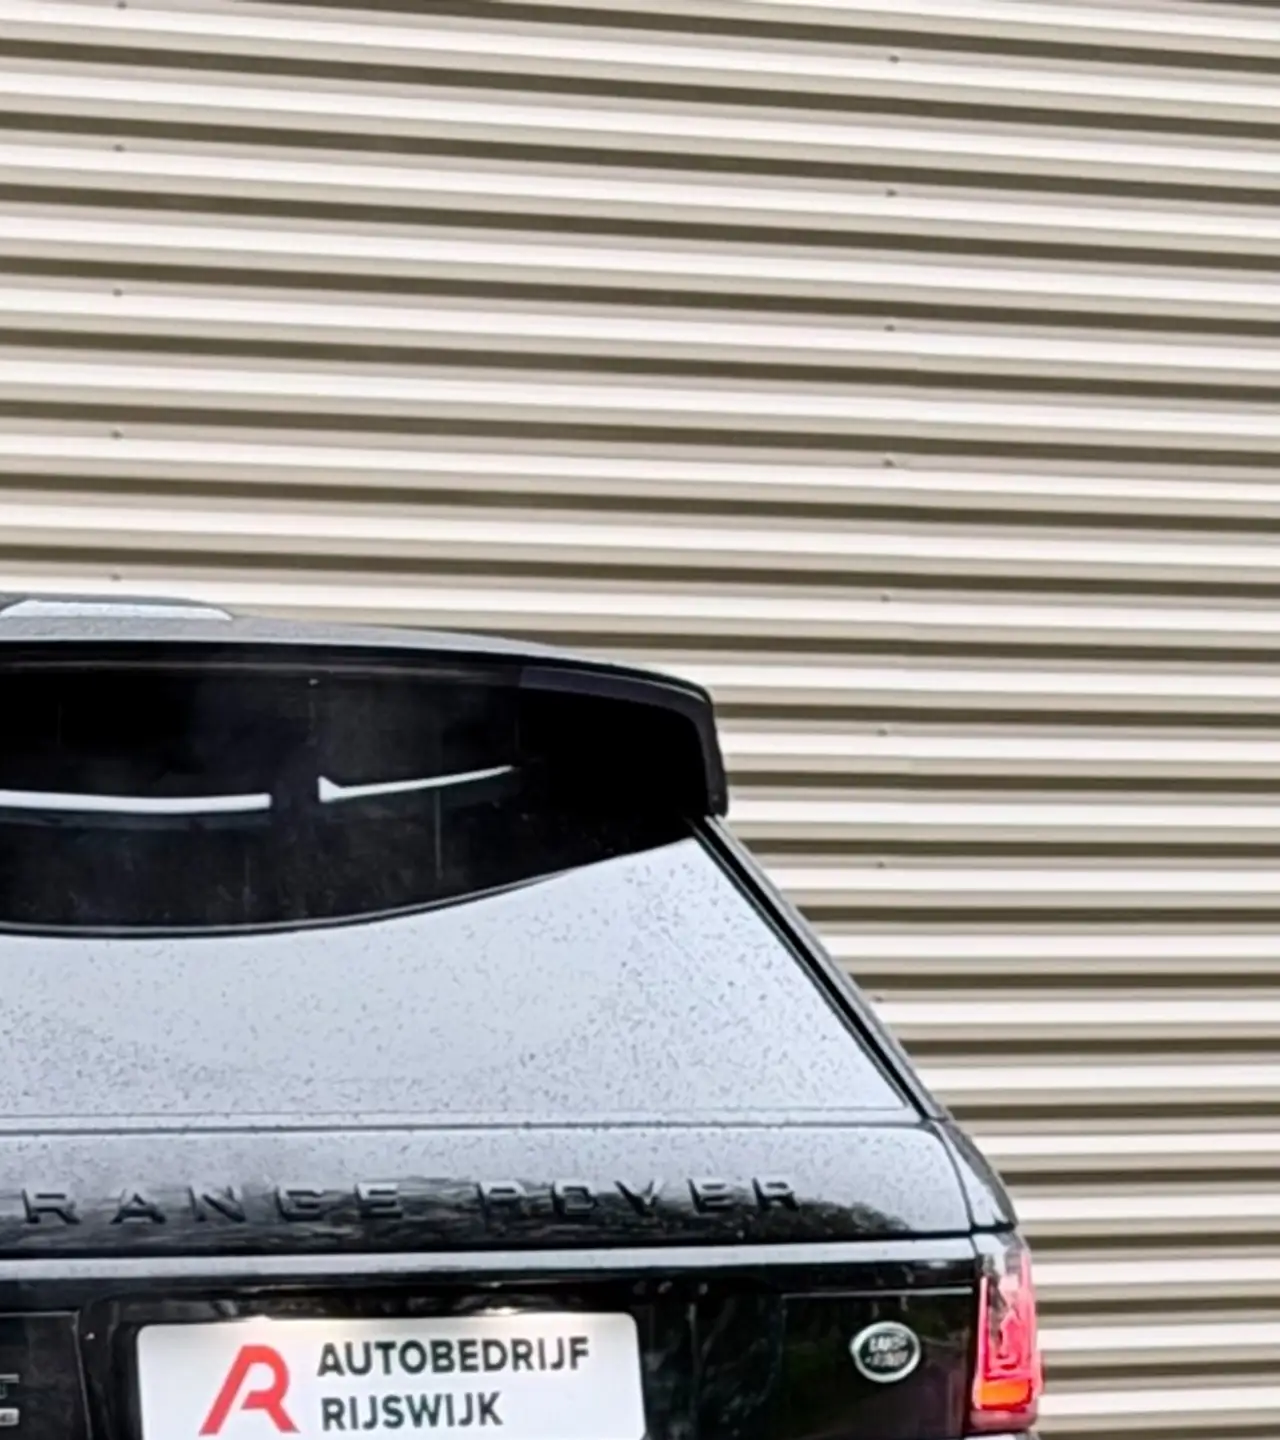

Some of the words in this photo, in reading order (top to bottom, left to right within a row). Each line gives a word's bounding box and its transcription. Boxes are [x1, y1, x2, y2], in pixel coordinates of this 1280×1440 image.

[22, 1182, 404, 1225] RANGE
[316, 1336, 590, 1377] AUTOBEDRIJF
[321, 1391, 503, 1431] RIJSWIJK
